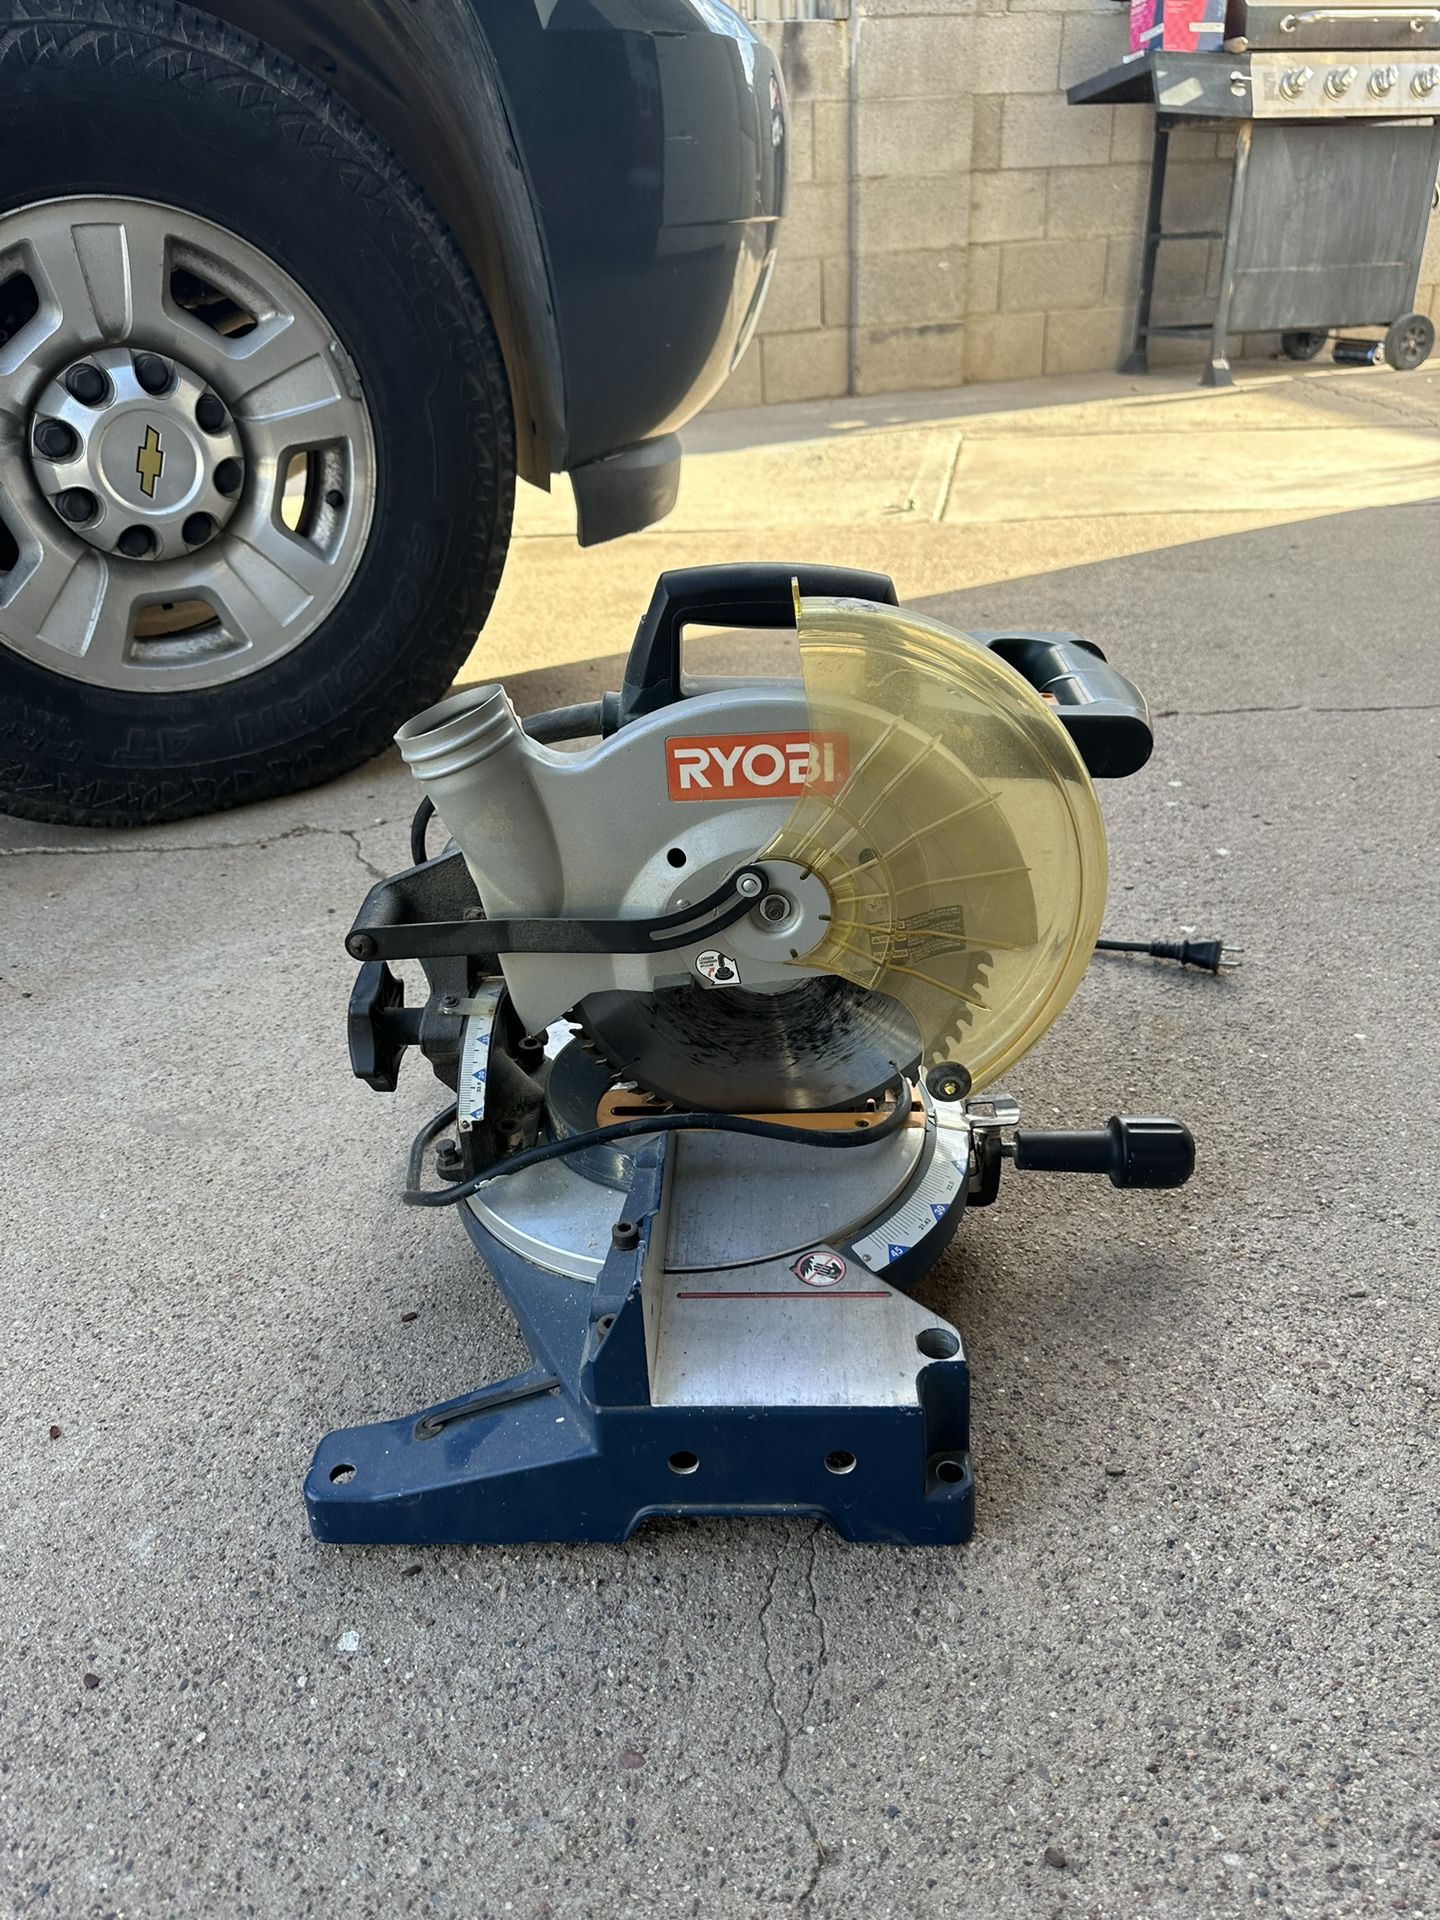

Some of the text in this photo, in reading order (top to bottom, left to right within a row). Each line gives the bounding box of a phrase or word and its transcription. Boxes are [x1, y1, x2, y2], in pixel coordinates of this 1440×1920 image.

[674, 742, 835, 790] RYOBI
[934, 1204, 946, 1216] 30
[890, 1247, 903, 1257] 45
